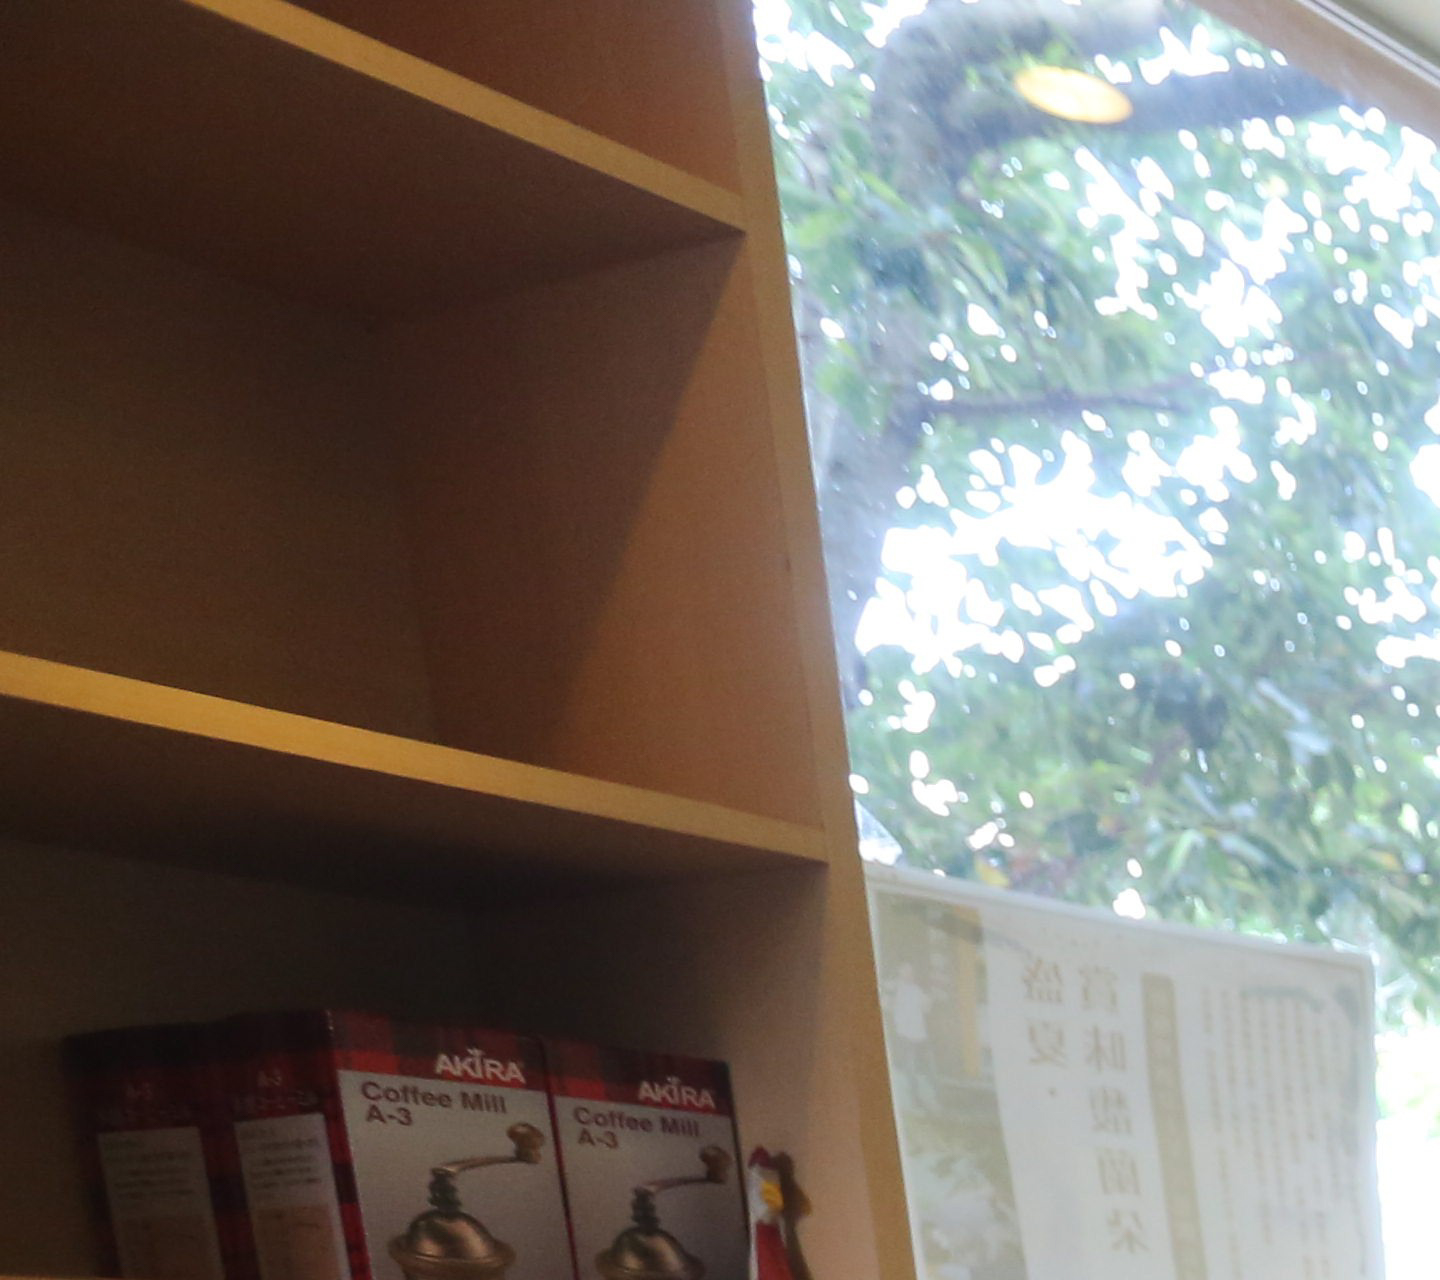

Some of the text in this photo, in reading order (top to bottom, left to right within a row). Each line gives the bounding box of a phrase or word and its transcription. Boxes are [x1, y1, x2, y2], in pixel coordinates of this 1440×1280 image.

[434, 1049, 527, 1084] AKIRA
[361, 1081, 507, 1115] Coffee Mill
[637, 1077, 716, 1110] AKIRA
[366, 1105, 414, 1126] A-3
[573, 1106, 700, 1138] Coffee Mill
[577, 1131, 619, 1149] A-3
